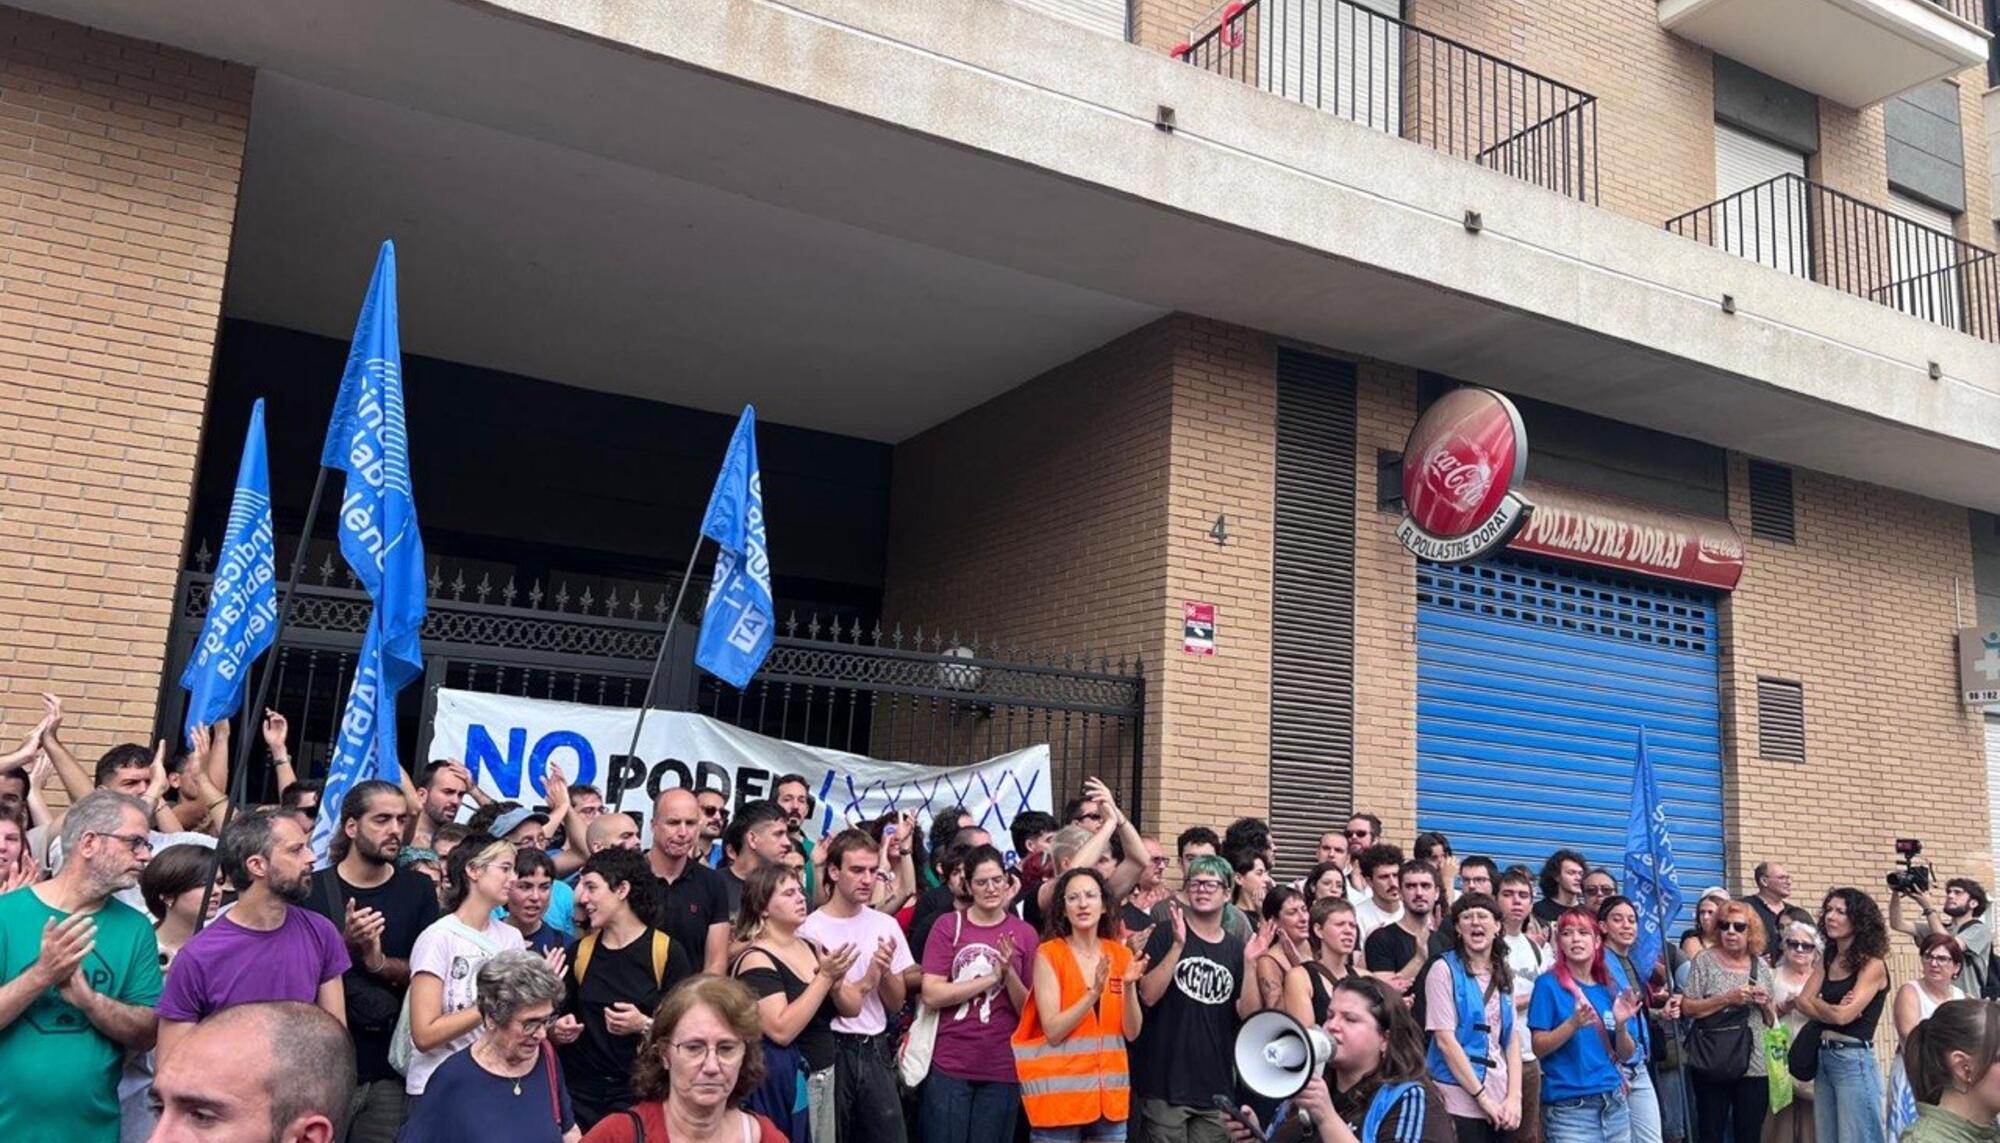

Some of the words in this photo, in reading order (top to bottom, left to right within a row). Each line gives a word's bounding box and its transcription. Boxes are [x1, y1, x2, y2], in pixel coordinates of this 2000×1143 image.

[1209, 515, 1227, 546] 4
[1401, 526, 1414, 545] EL
[1411, 535, 1471, 560] POLLASTRE
[1471, 508, 1508, 549] DORAT
[1524, 507, 1629, 559] POLLASTRE
[1626, 524, 1687, 569] DORAT
[464, 723, 597, 799] NO
[604, 754, 814, 818] PODE
